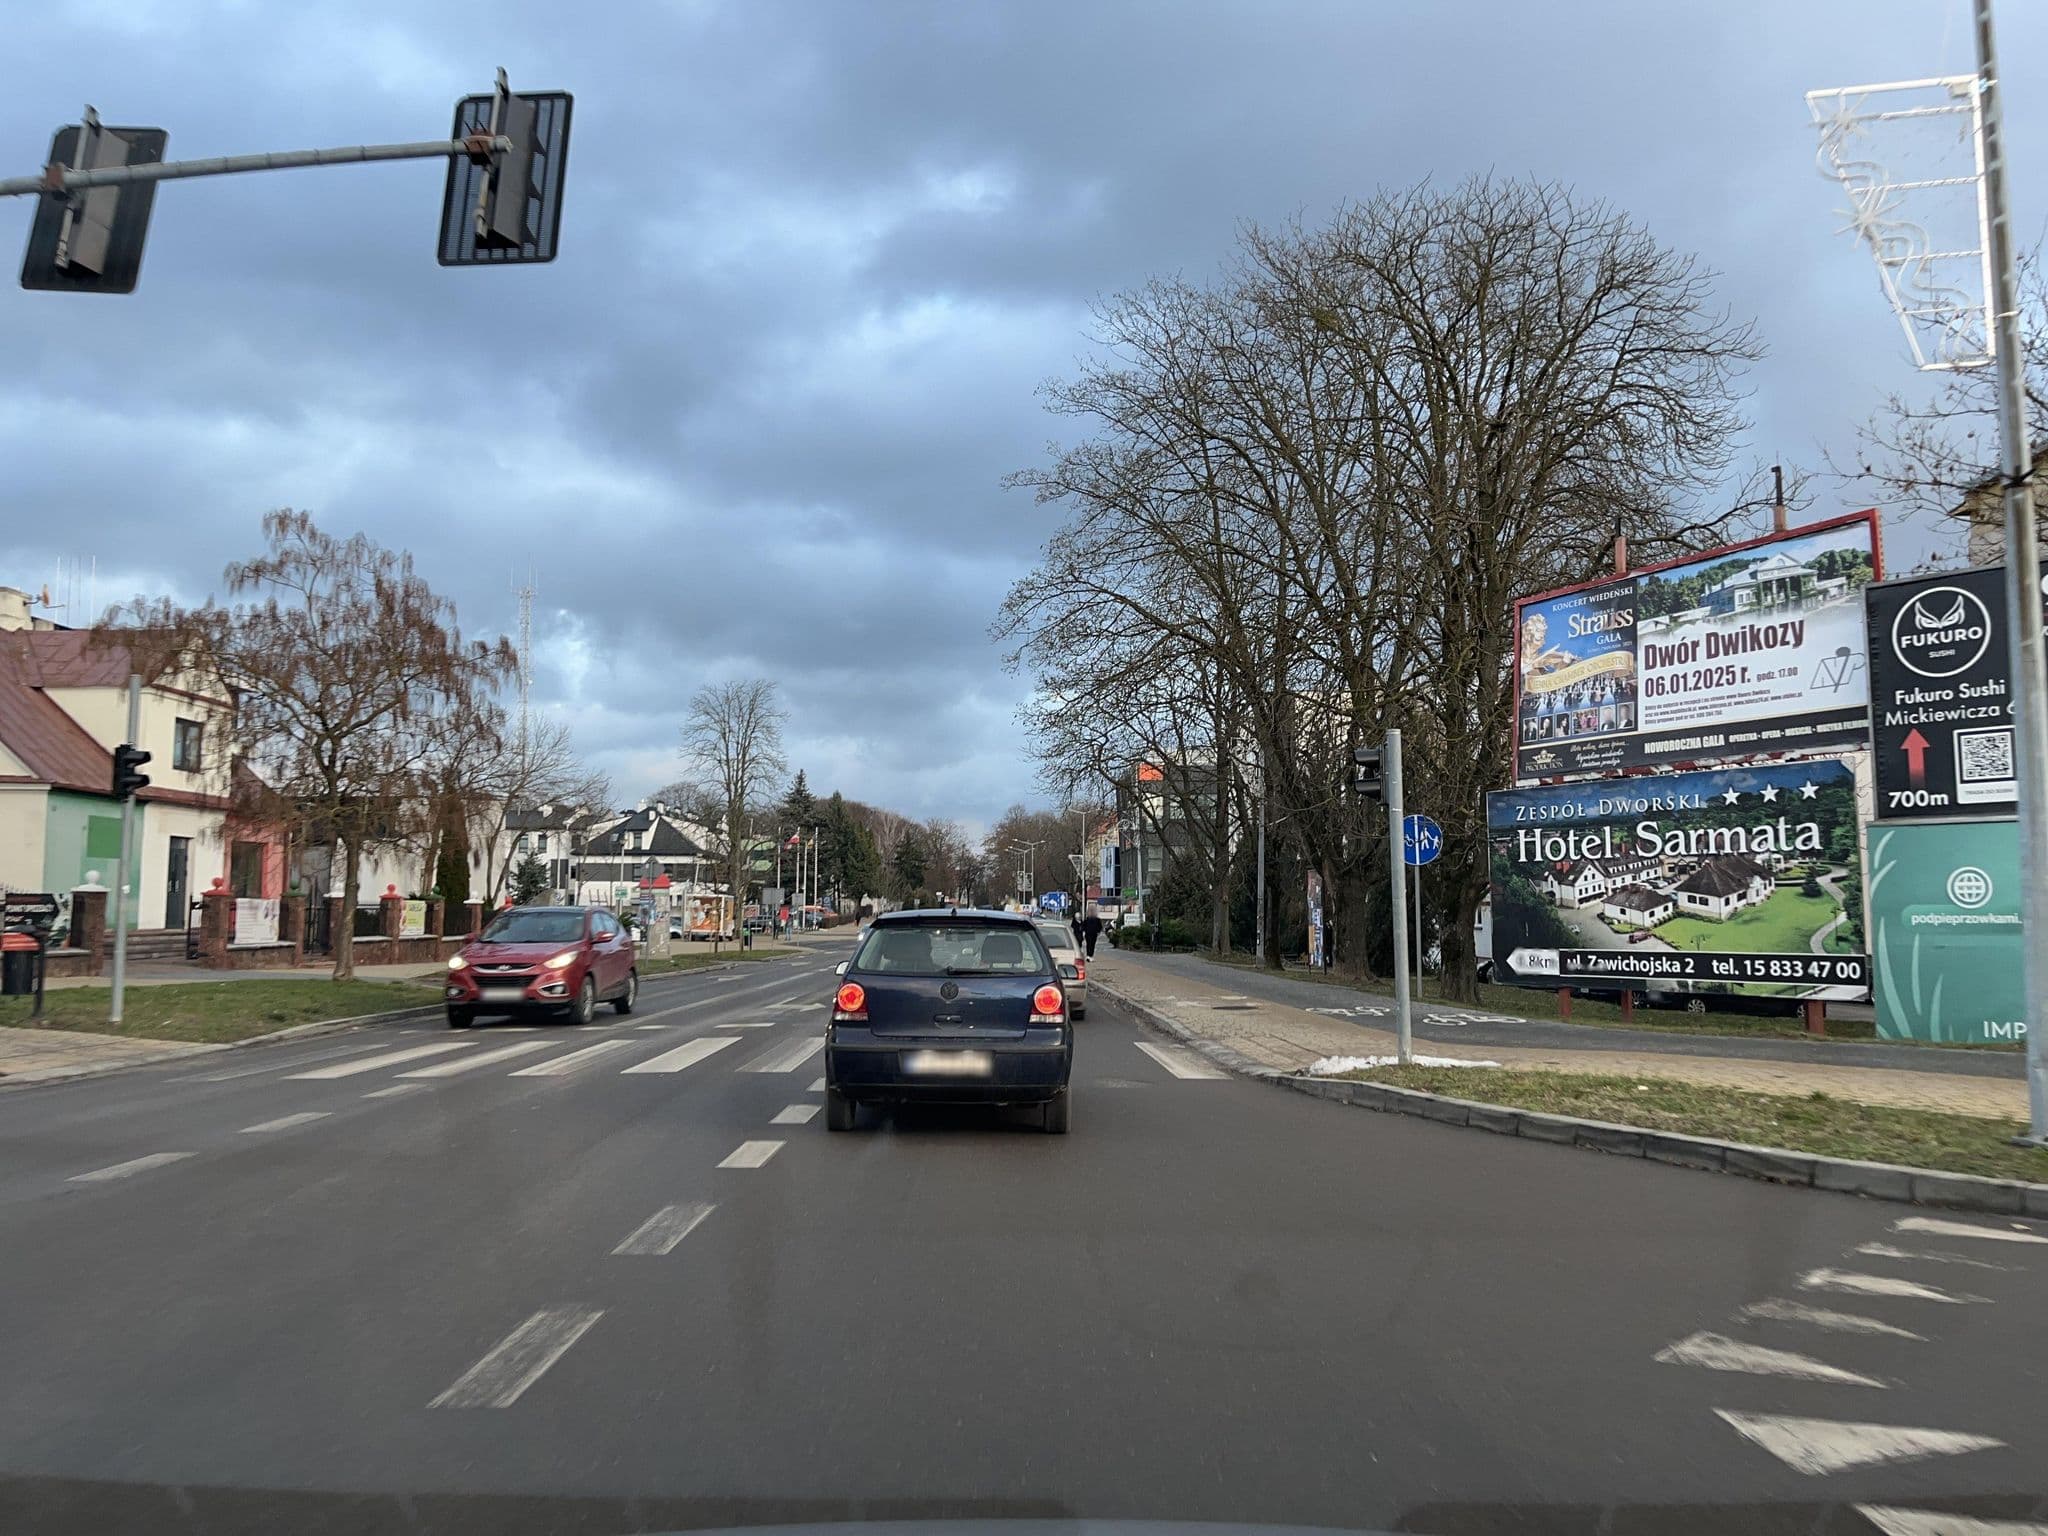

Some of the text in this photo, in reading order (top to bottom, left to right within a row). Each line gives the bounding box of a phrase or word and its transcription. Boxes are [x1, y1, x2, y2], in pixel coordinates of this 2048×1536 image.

[1552, 597, 1587, 612] KONCERT
[1568, 608, 1634, 639] Strauss
[1596, 632, 1622, 645] GALA
[1644, 619, 1805, 671] Dwór Dwikozy
[1901, 626, 1983, 649] FUKURO
[1928, 648, 1956, 659] SUSHI
[1645, 664, 1737, 698] 06.01.2025
[1740, 666, 1751, 683] r.
[1895, 679, 2006, 705] Fukuro Sushi
[1884, 705, 2001, 726] Mickiewicza
[1644, 737, 1702, 754] NOWOROCZNA
[1702, 734, 1725, 748] GALA
[1516, 794, 1701, 821] ZESPÓŁ DWORSKI
[1888, 789, 1949, 808] 700m
[1517, 815, 1824, 863] Hotel Sarmata
[1684, 957, 1695, 974] 2
[1712, 957, 1861, 979] tel. 15 833 47 00
